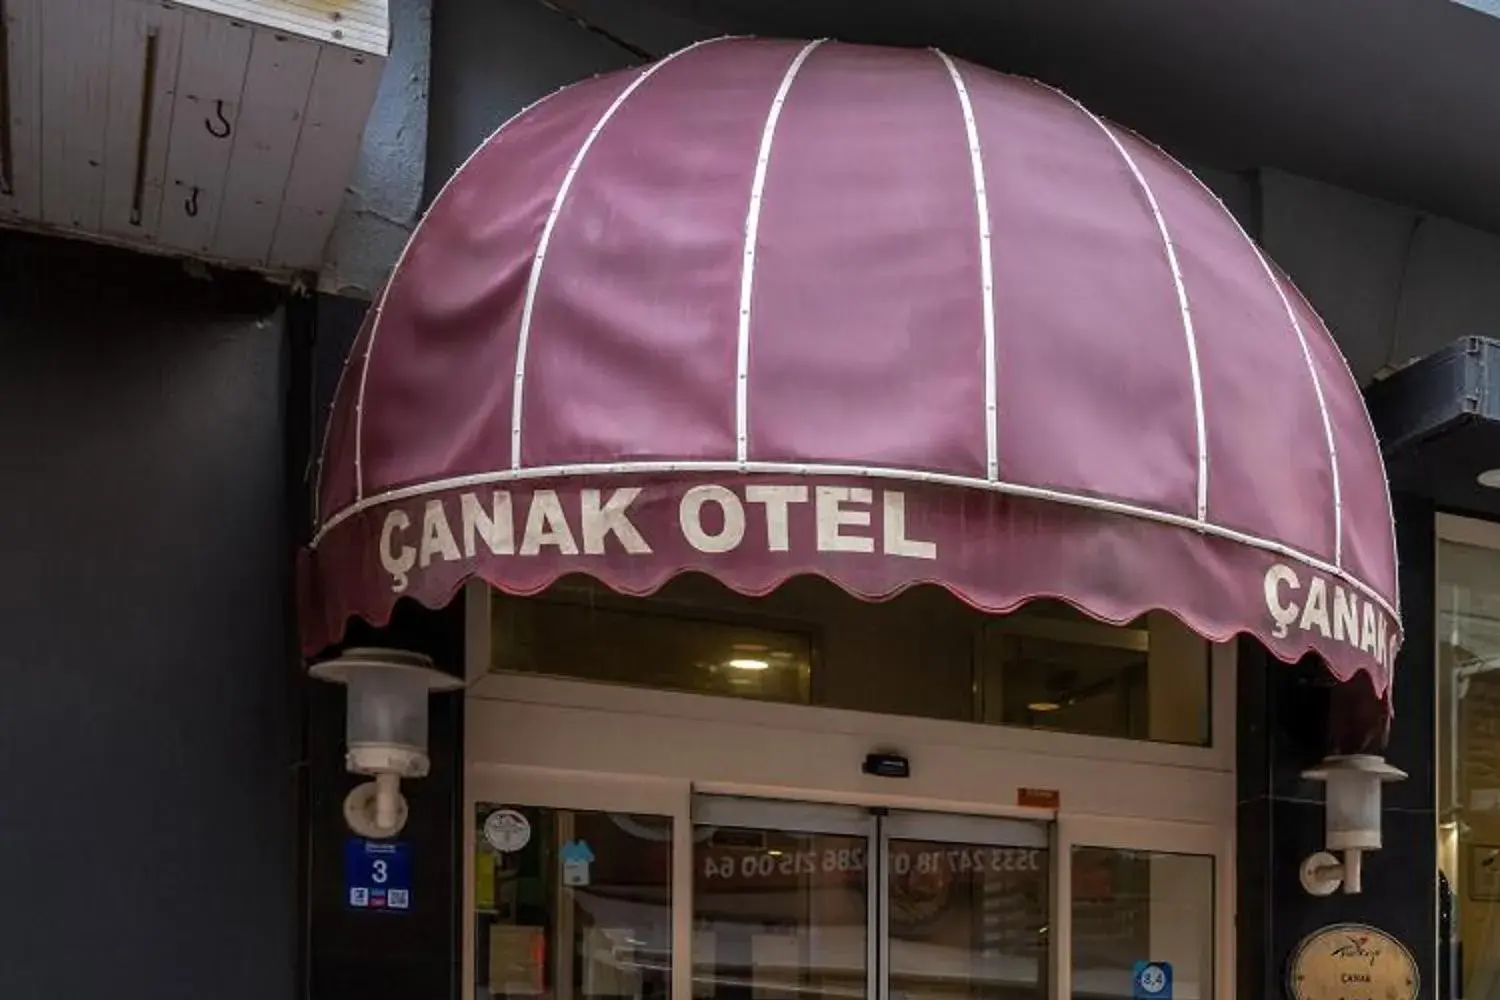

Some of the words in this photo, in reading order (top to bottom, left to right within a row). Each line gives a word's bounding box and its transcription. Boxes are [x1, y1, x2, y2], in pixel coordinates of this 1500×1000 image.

[379, 487, 652, 592] ÇANAK
[679, 484, 937, 560] OTEL
[371, 859, 388, 883] 3
